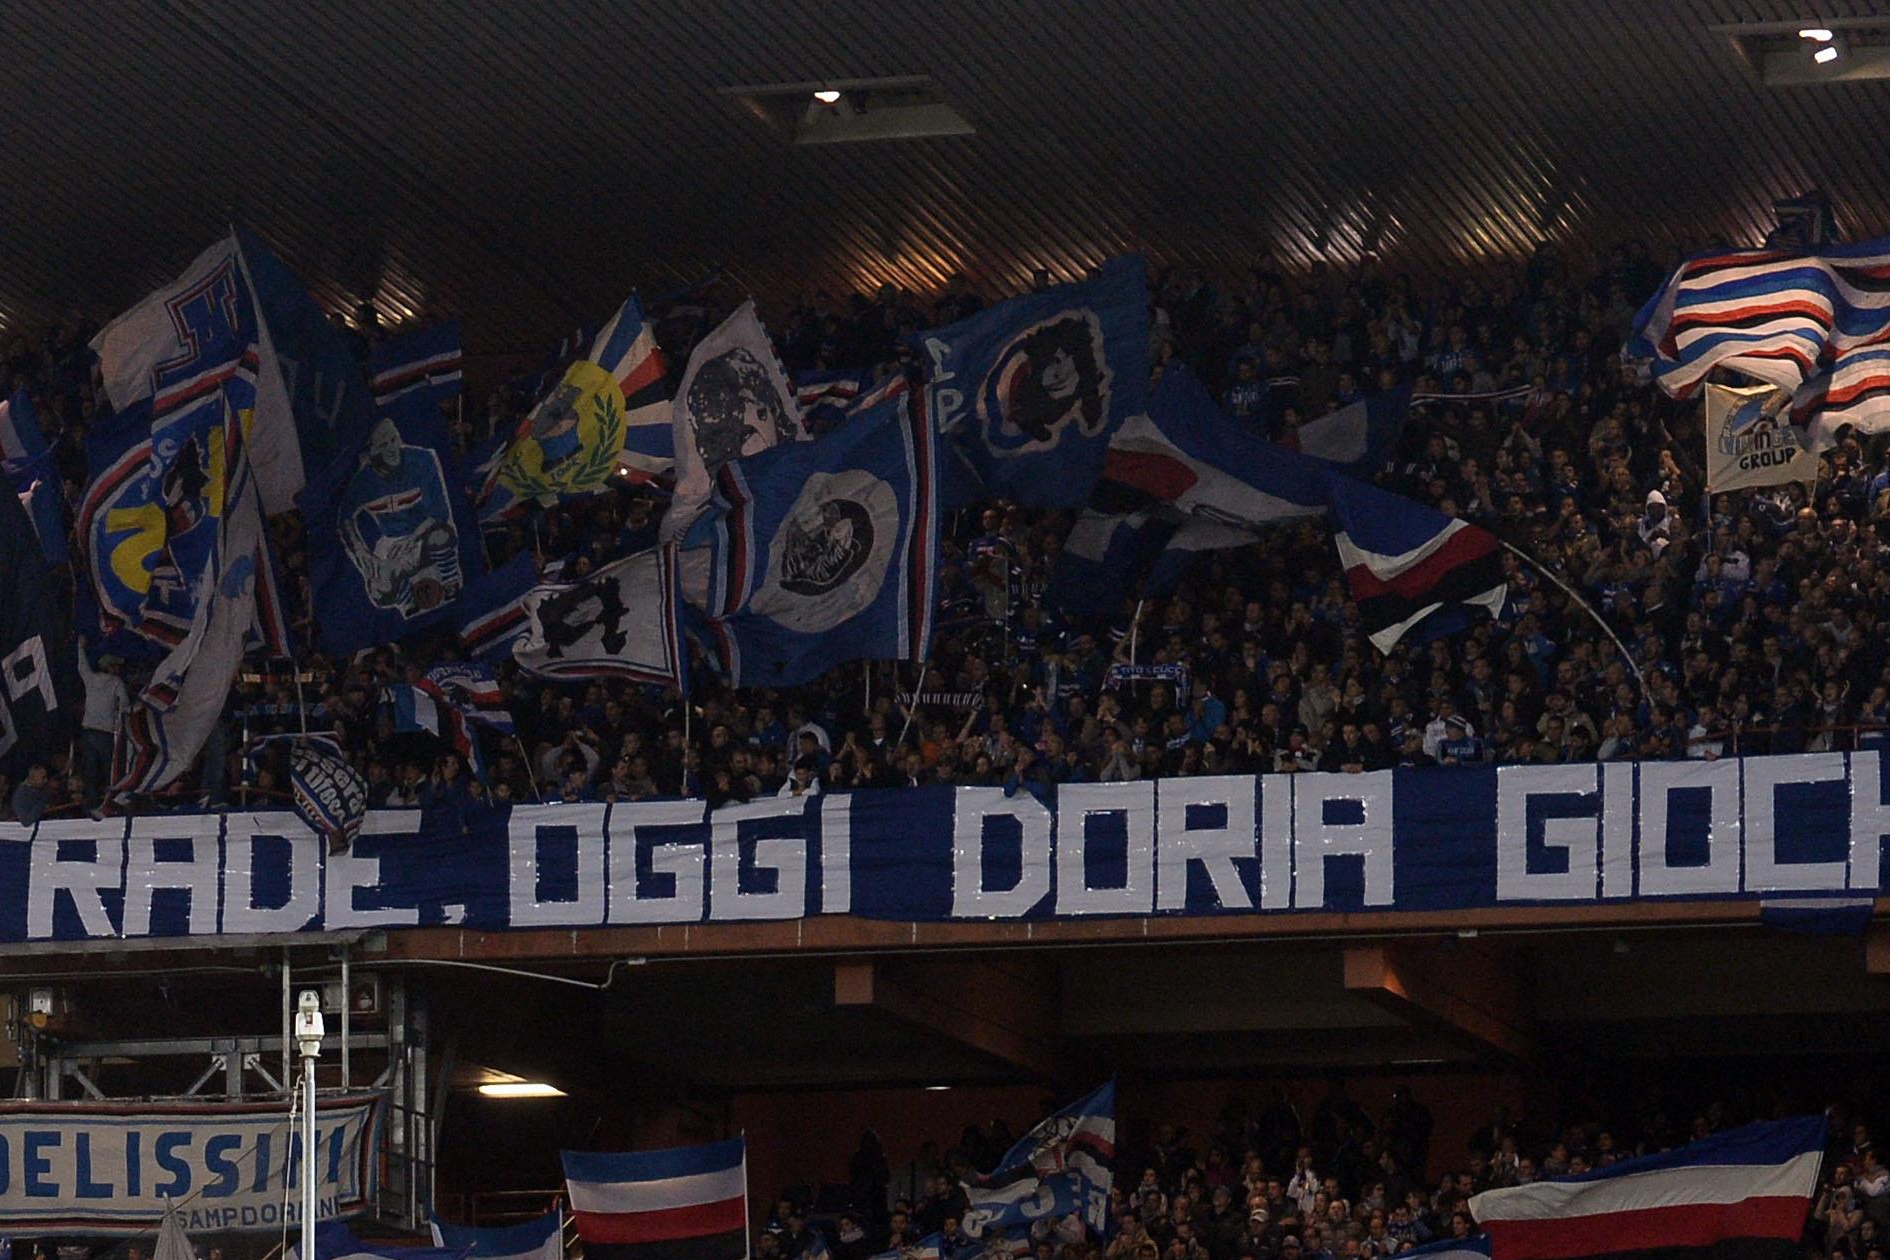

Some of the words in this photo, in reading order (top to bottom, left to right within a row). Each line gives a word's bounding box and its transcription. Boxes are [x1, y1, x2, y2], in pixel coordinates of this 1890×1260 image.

[1740, 447, 1796, 470] GROUP
[508, 793, 851, 926] OGGI
[951, 769, 1394, 920] DORIA
[176, 1196, 341, 1230] SAMPDORINI
